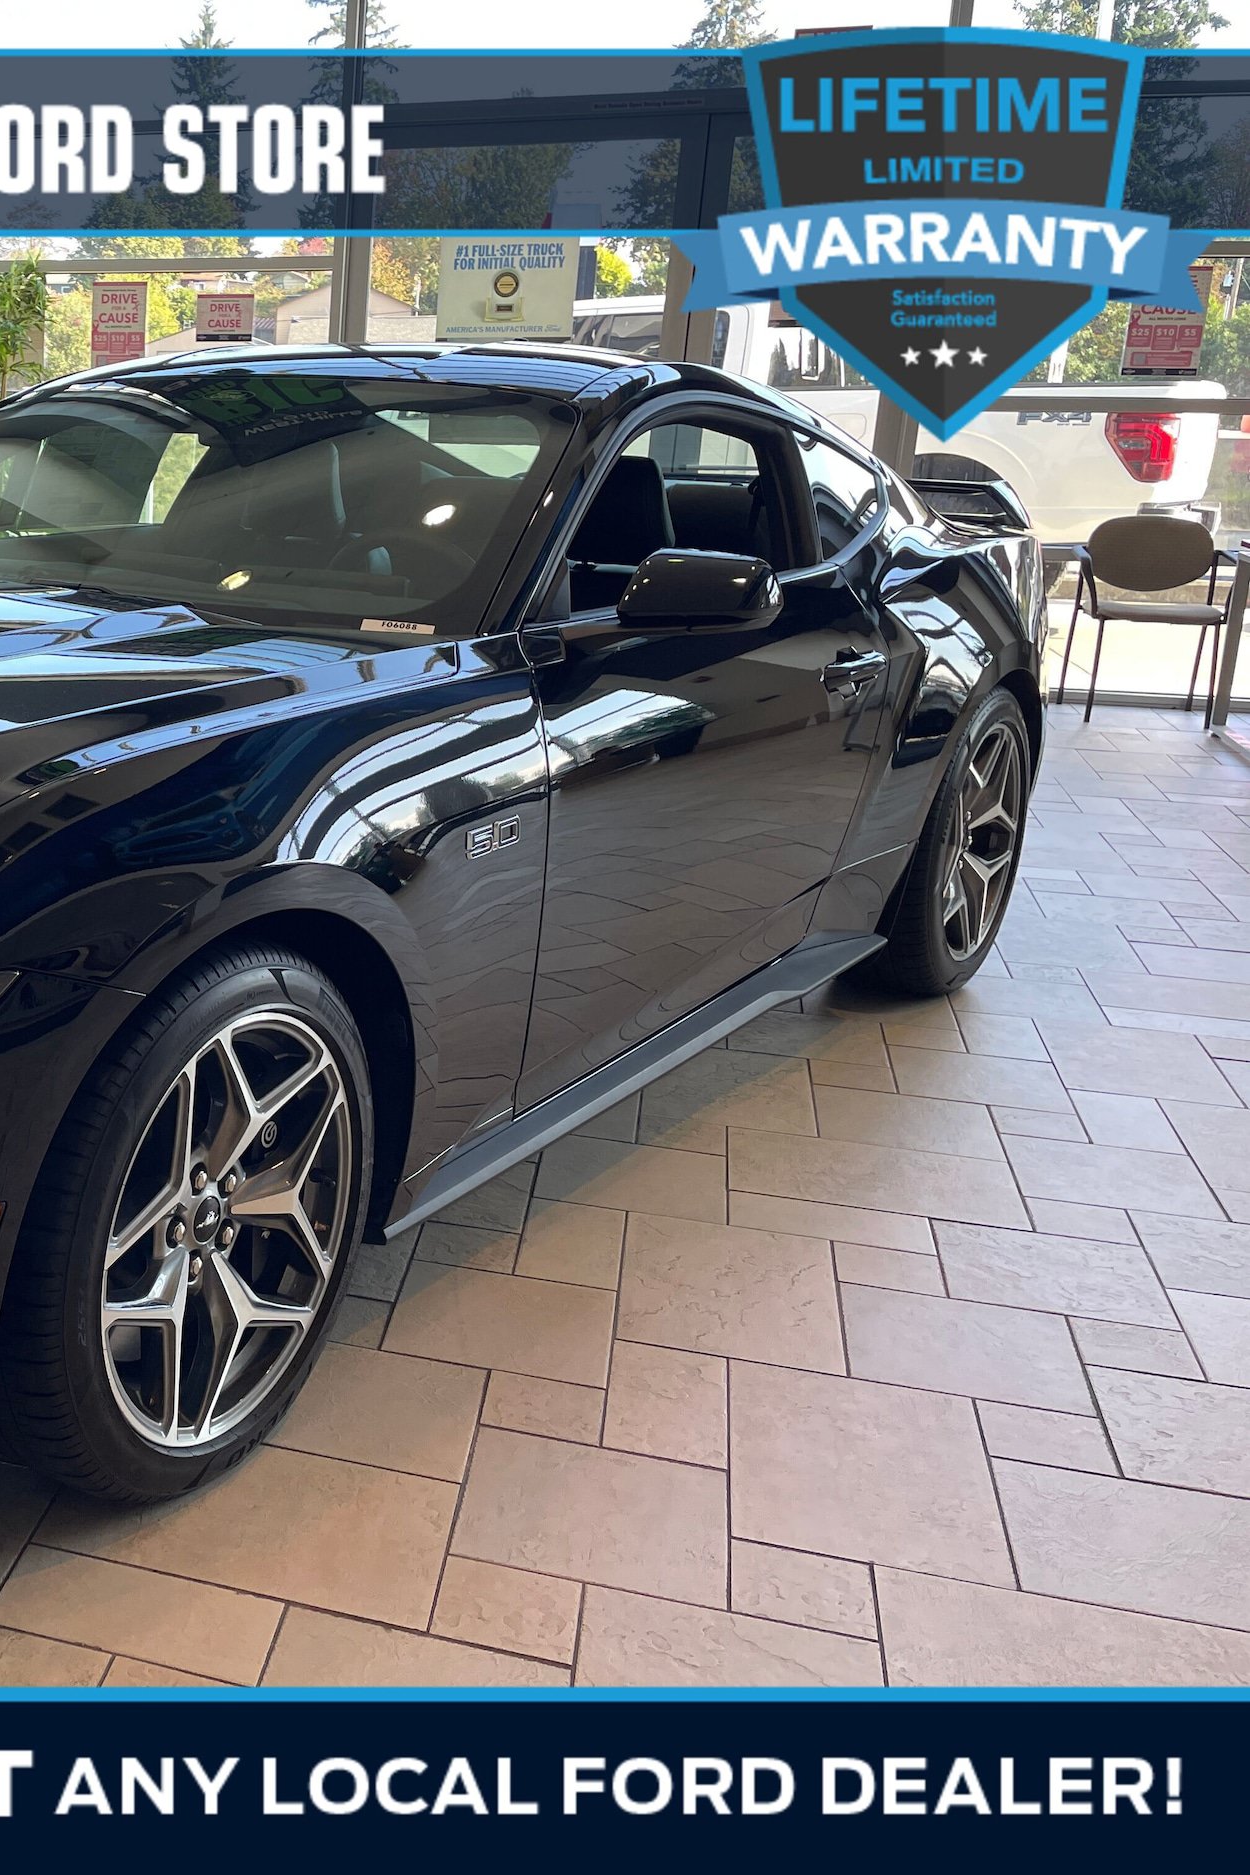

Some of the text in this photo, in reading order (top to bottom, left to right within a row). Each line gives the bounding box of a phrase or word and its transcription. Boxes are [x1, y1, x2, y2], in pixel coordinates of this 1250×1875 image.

[456, 243, 564, 257] #1 FULL-SIZE TRUCK
[454, 256, 565, 271] FOR INITIAL QUALITY
[101, 294, 138, 304] DRIVE
[210, 304, 240, 312] DRIVE
[1141, 304, 1196, 315] CAU
[100, 313, 139, 324] CAUSE
[208, 320, 241, 328] CAUSE
[446, 326, 484, 334] AMERICA'S
[485, 325, 543, 333] MANUFACTURER
[1131, 328, 1197, 337] $25 $10 $5
[1016, 411, 1092, 426] FX4
[466, 814, 520, 860] 5.0
